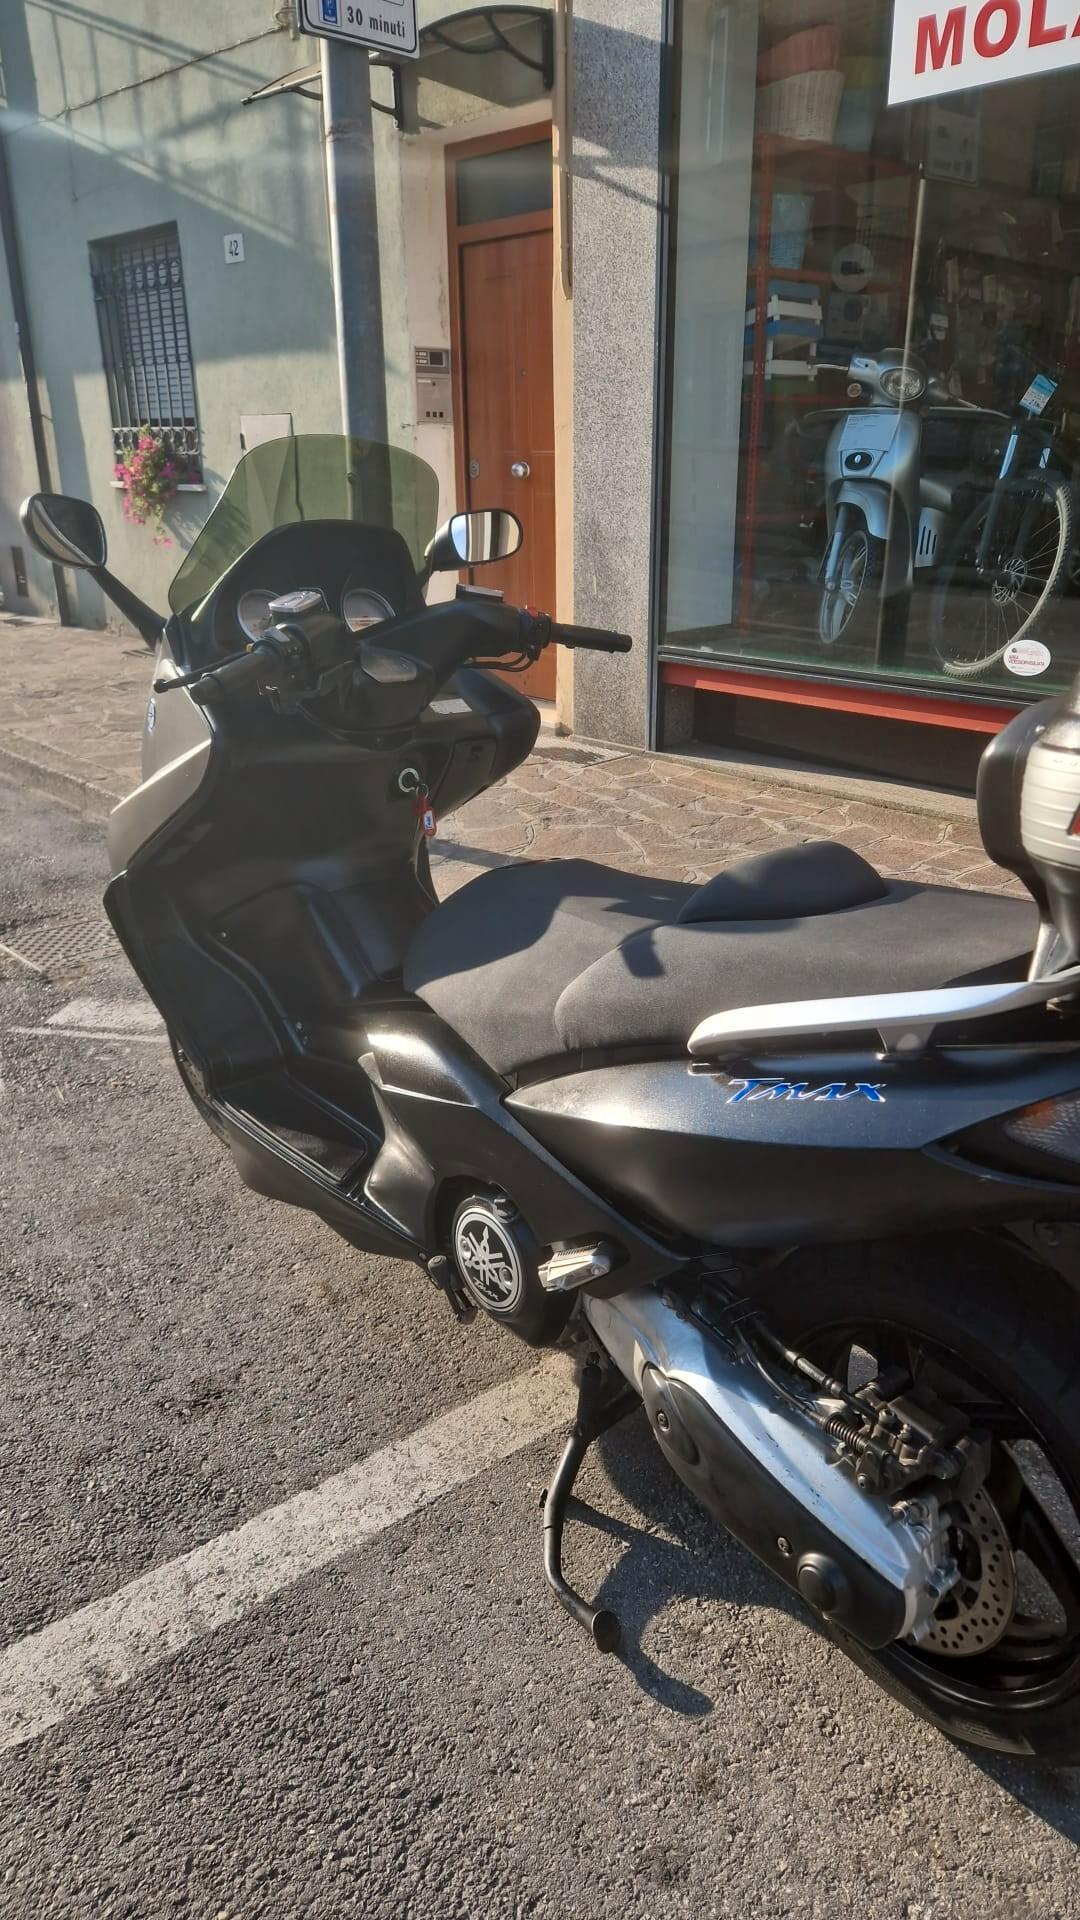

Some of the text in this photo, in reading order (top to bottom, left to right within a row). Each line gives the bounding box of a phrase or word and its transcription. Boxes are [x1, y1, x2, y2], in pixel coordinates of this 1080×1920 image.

[347, 6, 406, 38] 30 minuti
[914, 0, 1080, 75] MOL
[229, 239, 240, 256] 42
